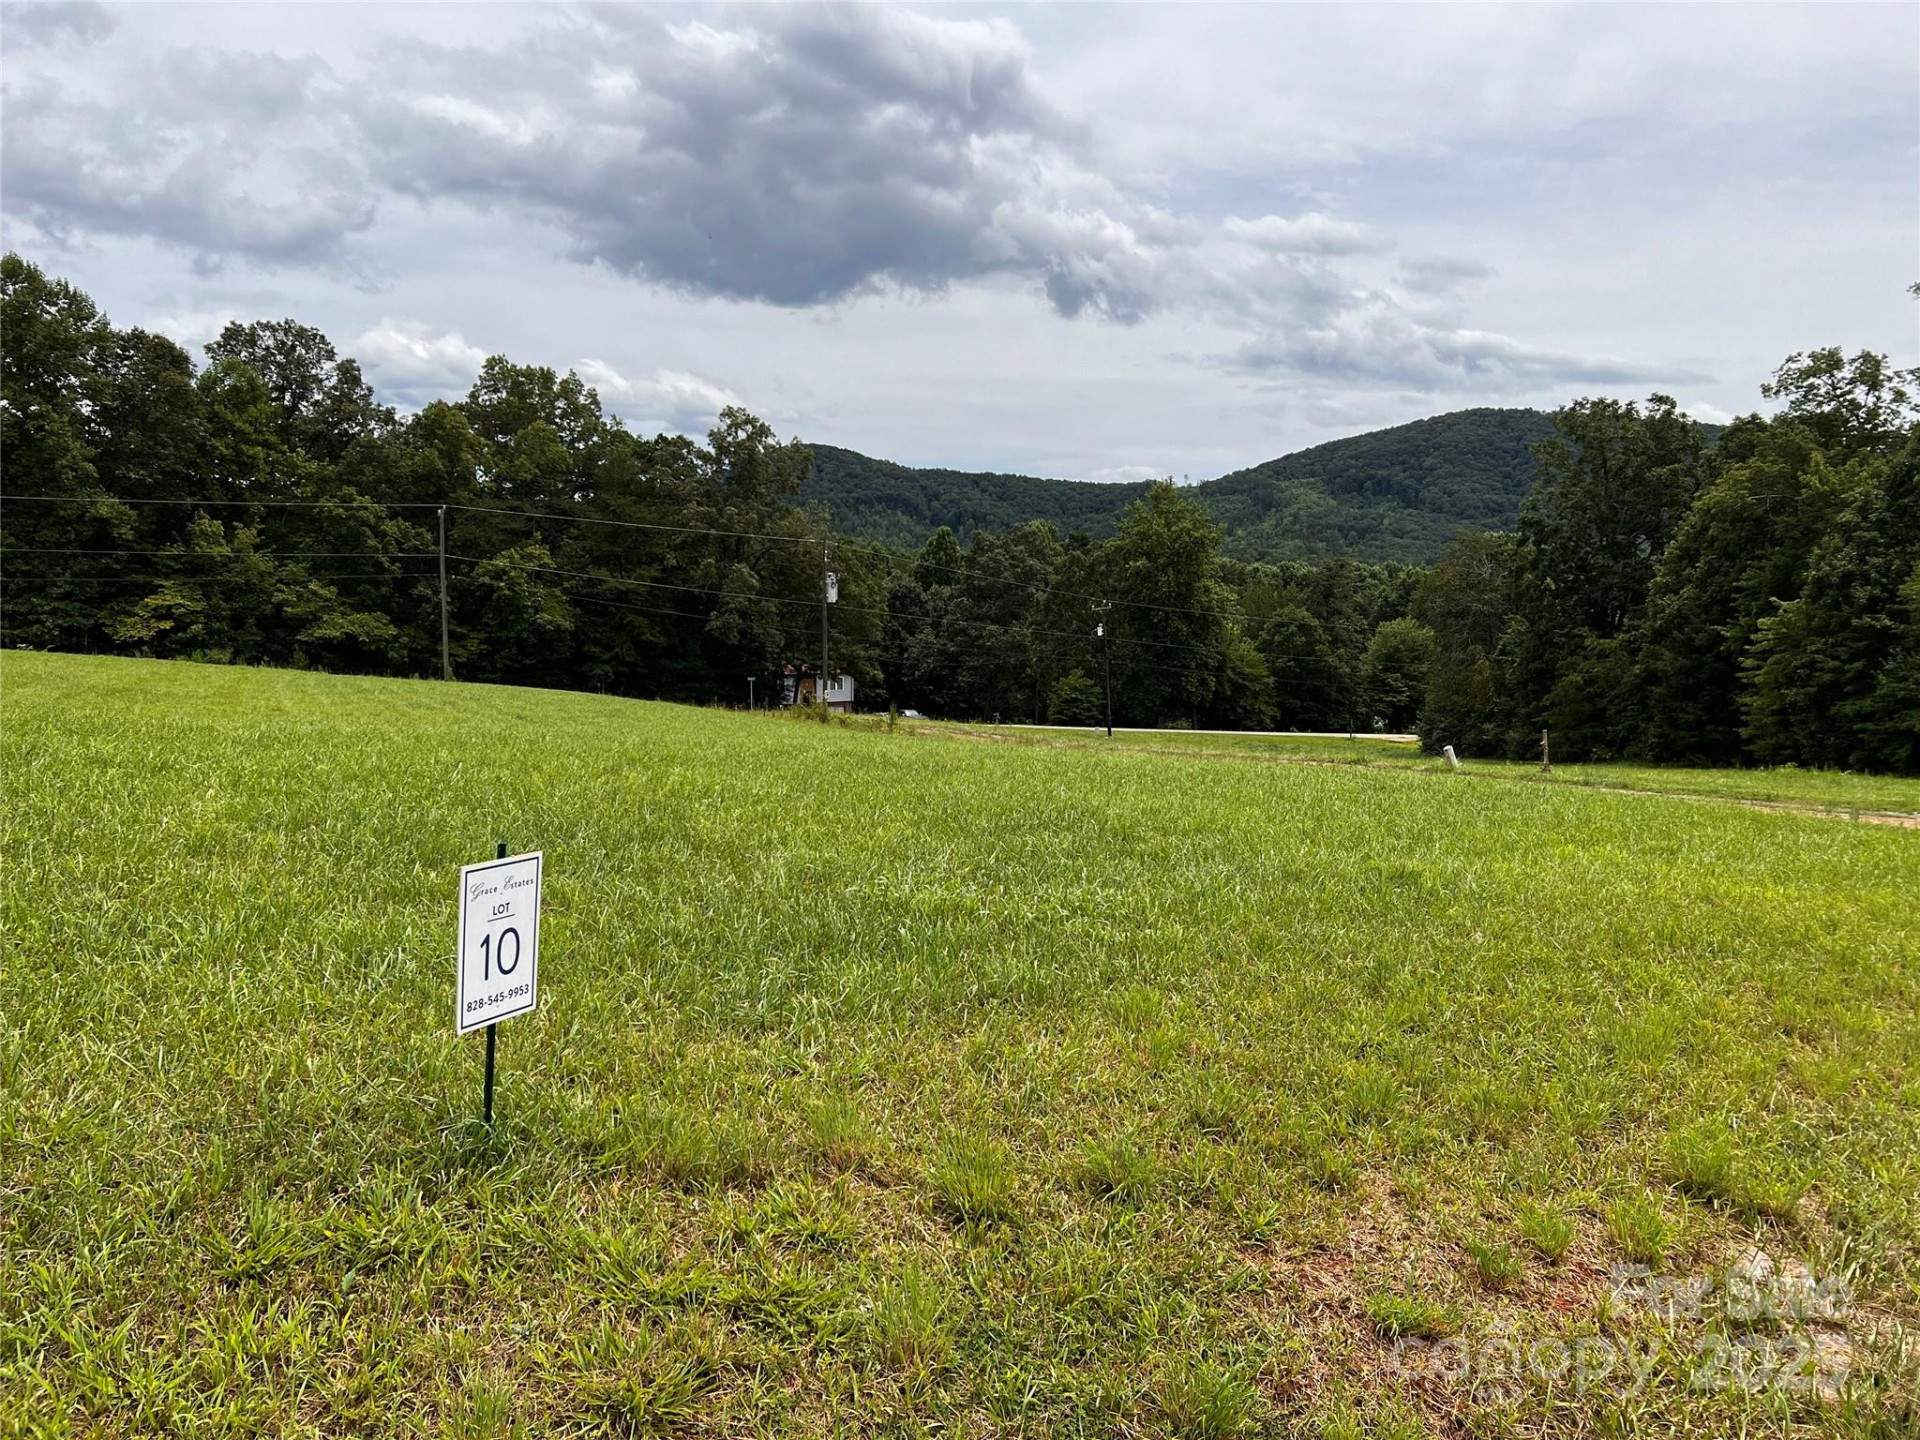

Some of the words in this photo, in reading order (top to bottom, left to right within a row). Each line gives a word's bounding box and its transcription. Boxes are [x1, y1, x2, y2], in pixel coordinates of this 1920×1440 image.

[470, 882, 498, 902] Grace
[503, 875, 534, 890] Estates
[492, 902, 510, 916] LOT
[480, 927, 520, 981] 10
[466, 984, 530, 1013] 828-545-9953
